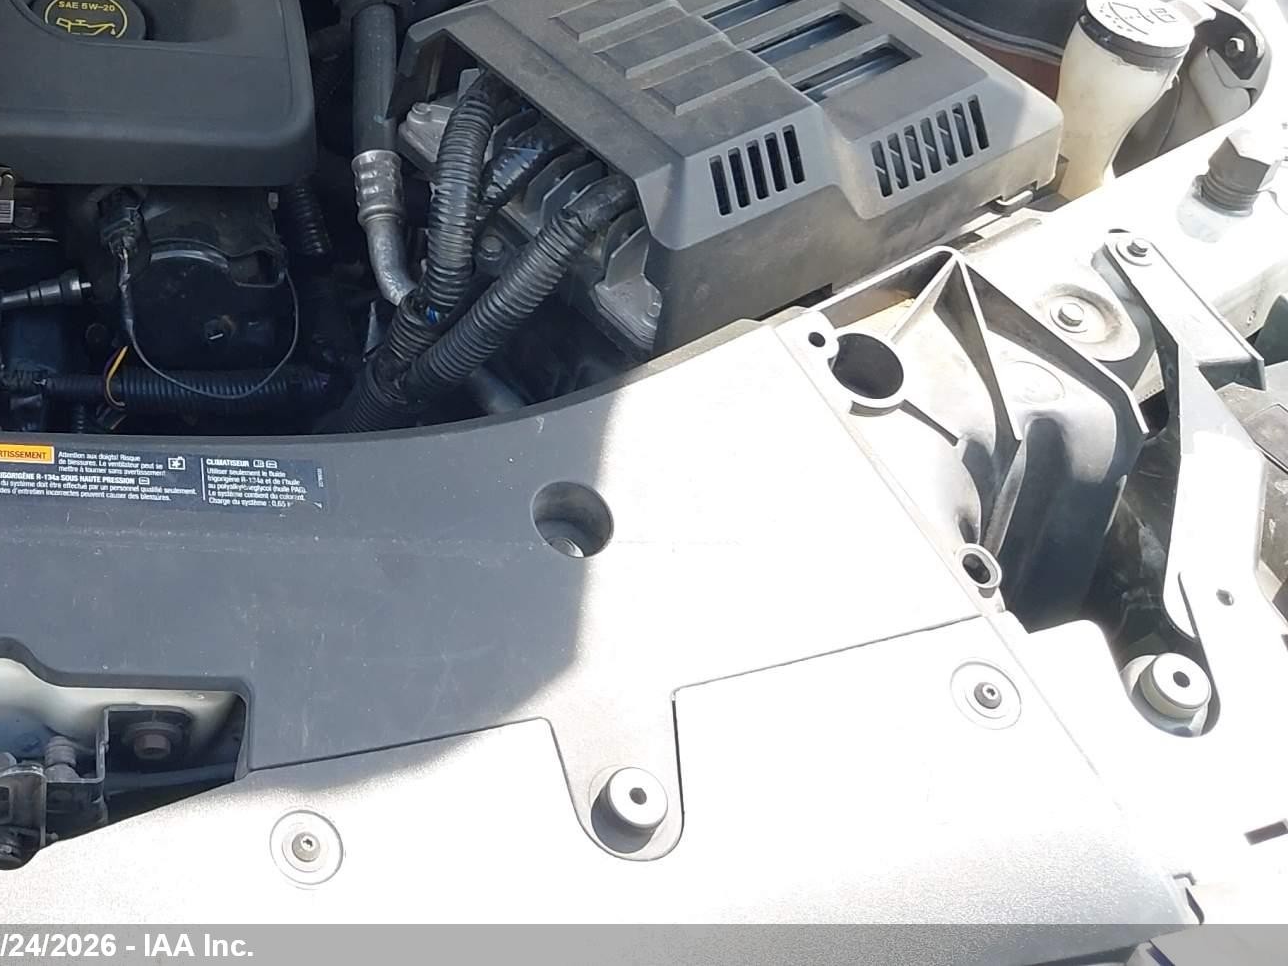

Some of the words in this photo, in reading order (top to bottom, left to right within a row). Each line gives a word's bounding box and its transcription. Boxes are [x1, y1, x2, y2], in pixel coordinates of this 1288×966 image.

[81, 3, 115, 11] 5W-20
[58, 451, 85, 459] Attention
[120, 454, 141, 462] Risque
[206, 458, 250, 467] CLIMATISEUR
[85, 466, 107, 474] tourner
[229, 468, 260, 476] seulement
[268, 470, 286, 478] fluide
[102, 476, 135, 484] PRESSION
[46, 488, 79, 496] incorrectes
[110, 484, 139, 493] personnel
[208, 498, 230, 506] Charge
